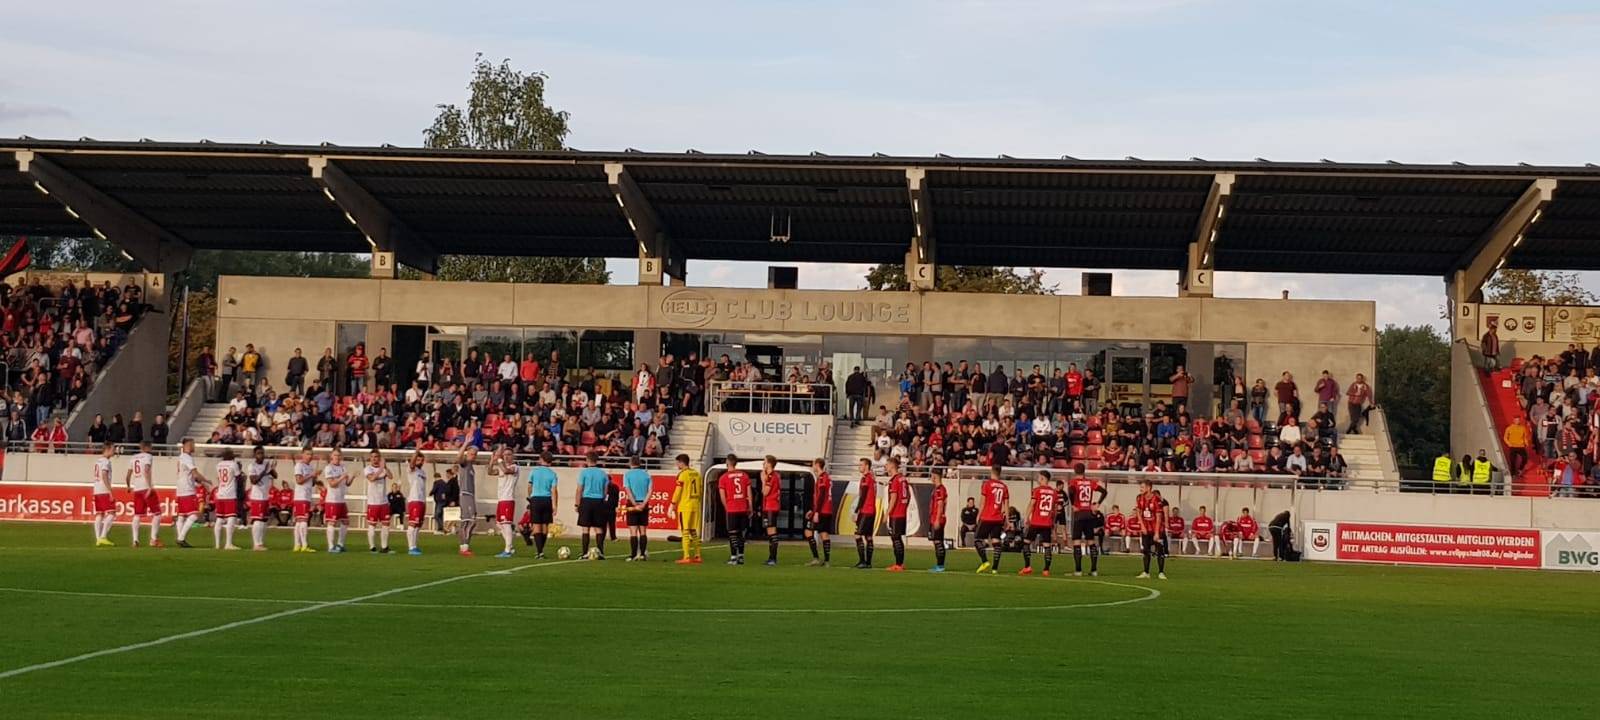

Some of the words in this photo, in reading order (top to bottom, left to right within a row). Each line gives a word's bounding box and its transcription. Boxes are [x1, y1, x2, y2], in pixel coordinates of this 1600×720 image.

[379, 255, 386, 266] B
[646, 261, 653, 273] B
[918, 267, 926, 279] C
[1197, 272, 1205, 284] C
[152, 276, 160, 287] A
[666, 301, 718, 315] HELLA
[726, 301, 793, 320] CLUB
[801, 303, 910, 323] LOUNGE
[1462, 306, 1470, 317] D
[753, 422, 812, 435] LIEBELT
[134, 460, 141, 474] 6
[219, 468, 229, 483] 18
[690, 479, 697, 494] 1
[734, 478, 742, 494] 5
[1079, 485, 1092, 501] 29
[1040, 494, 1053, 511] 23
[1341, 530, 1394, 542] MITMACHEN.
[1395, 532, 1456, 544] MITGESTALTEN.
[1457, 534, 1494, 546] MITGLIED
[1495, 536, 1535, 547] WERDEN!
[1341, 544, 1360, 553] JETZT
[1361, 545, 1388, 554] ANTRAG
[1558, 550, 1599, 566] BWG
